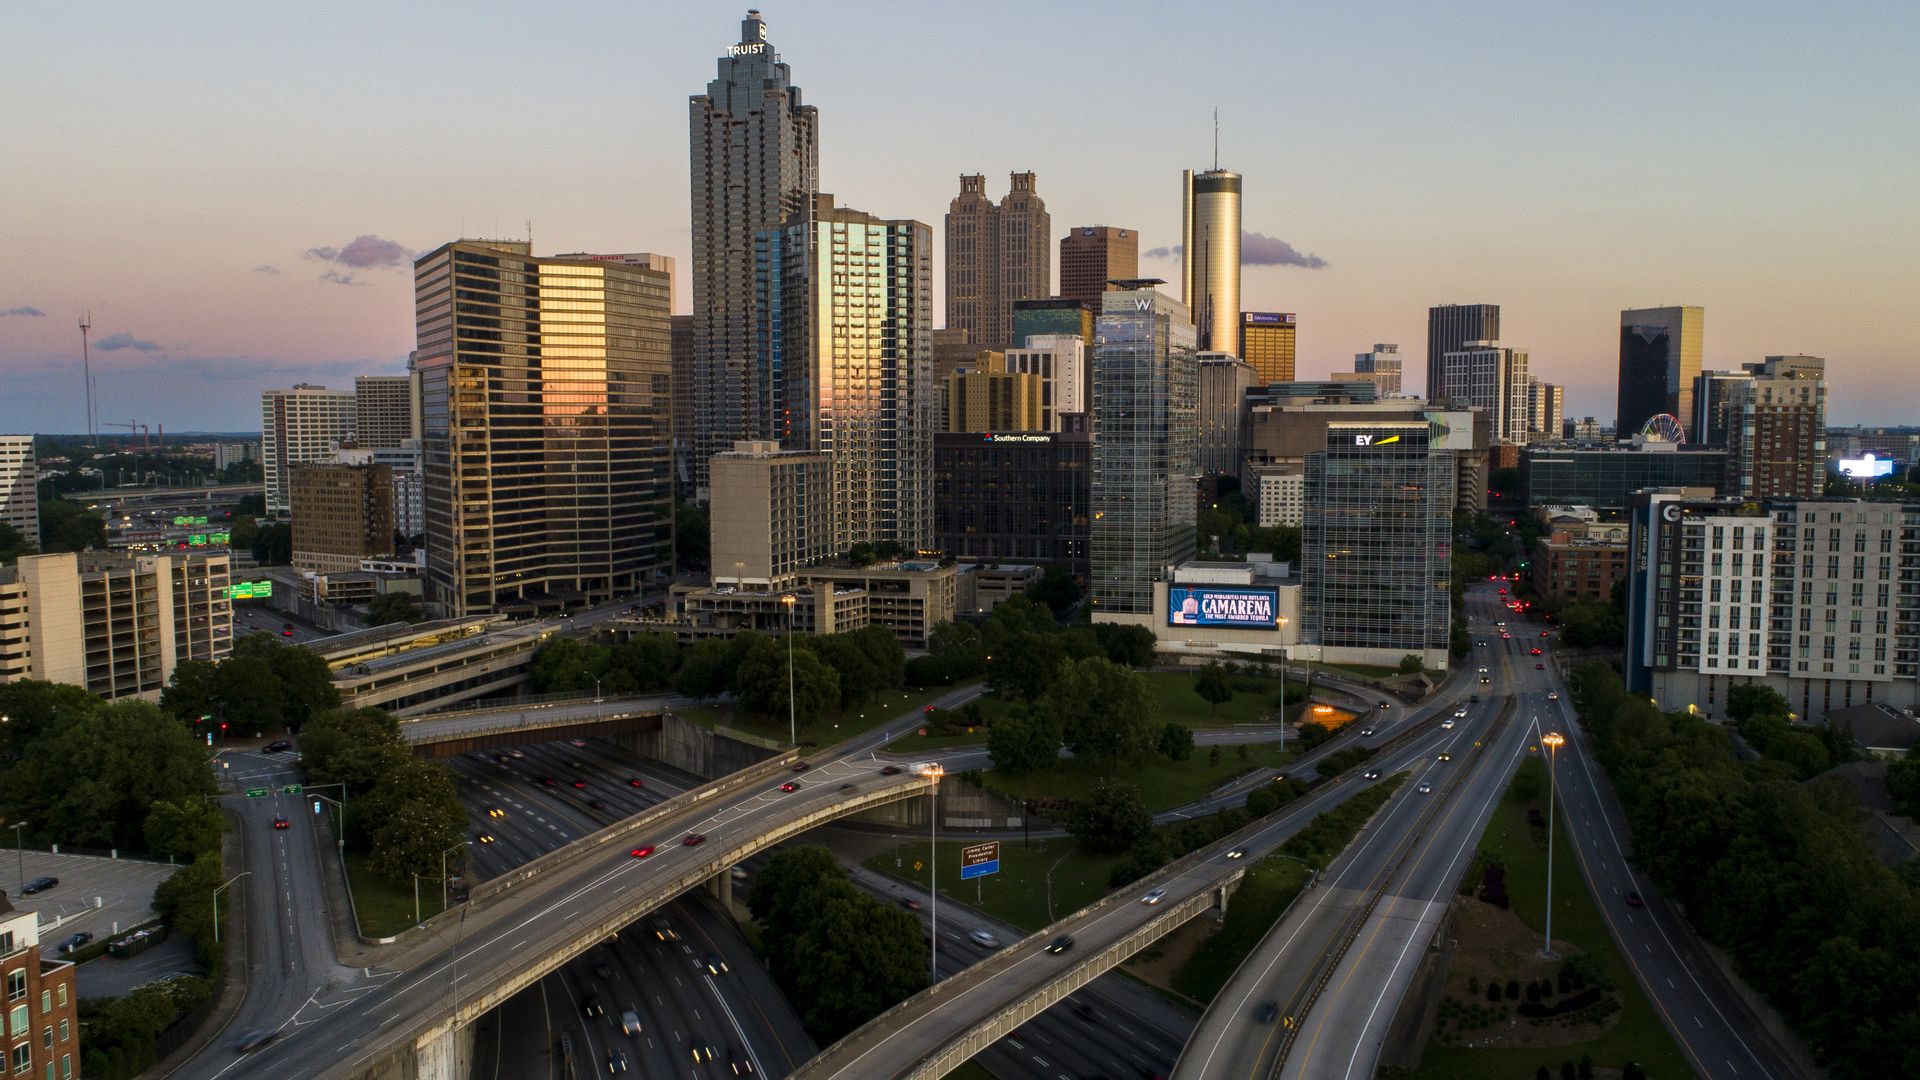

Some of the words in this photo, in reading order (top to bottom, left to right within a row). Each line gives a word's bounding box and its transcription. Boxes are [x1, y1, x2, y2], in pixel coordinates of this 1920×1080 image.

[727, 44, 765, 56] TRUIST
[1135, 298, 1152, 311] W
[994, 434, 1021, 442] Southern
[1022, 434, 1050, 443] Company
[1355, 435, 1372, 446] EY
[1663, 504, 1681, 521] G
[1202, 599, 1271, 616] CAMARENA
